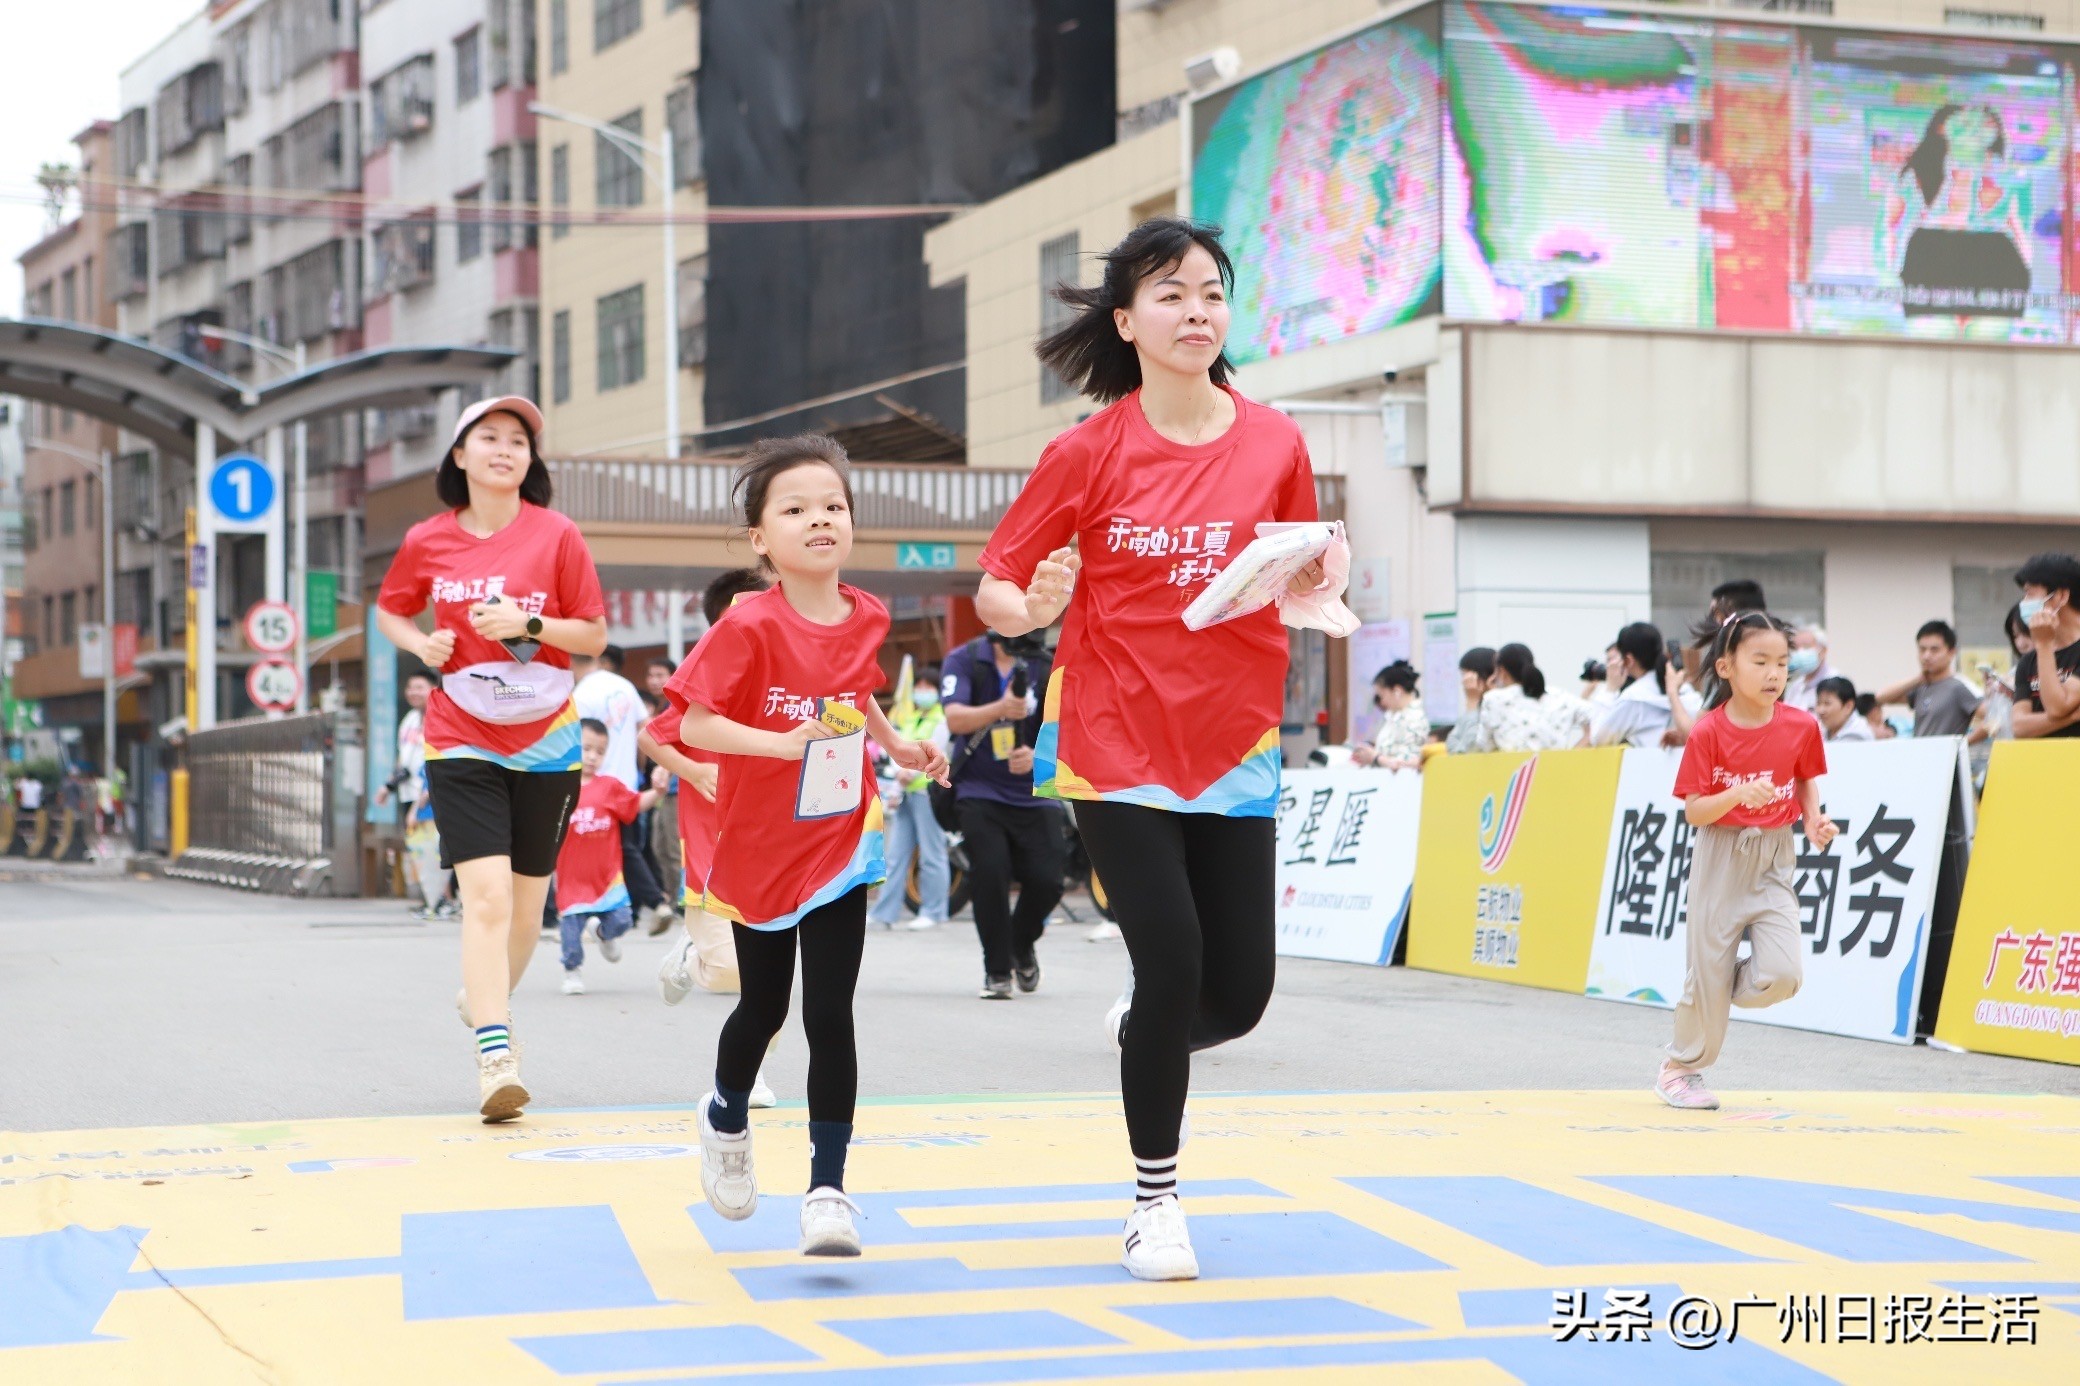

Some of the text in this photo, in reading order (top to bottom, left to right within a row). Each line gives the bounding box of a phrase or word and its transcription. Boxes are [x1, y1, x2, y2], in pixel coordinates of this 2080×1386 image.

[226, 467, 252, 513] 1
[904, 545, 950, 566] 入口
[258, 614, 289, 642] 15
[1975, 1001, 2060, 1032] GUANGDONG
